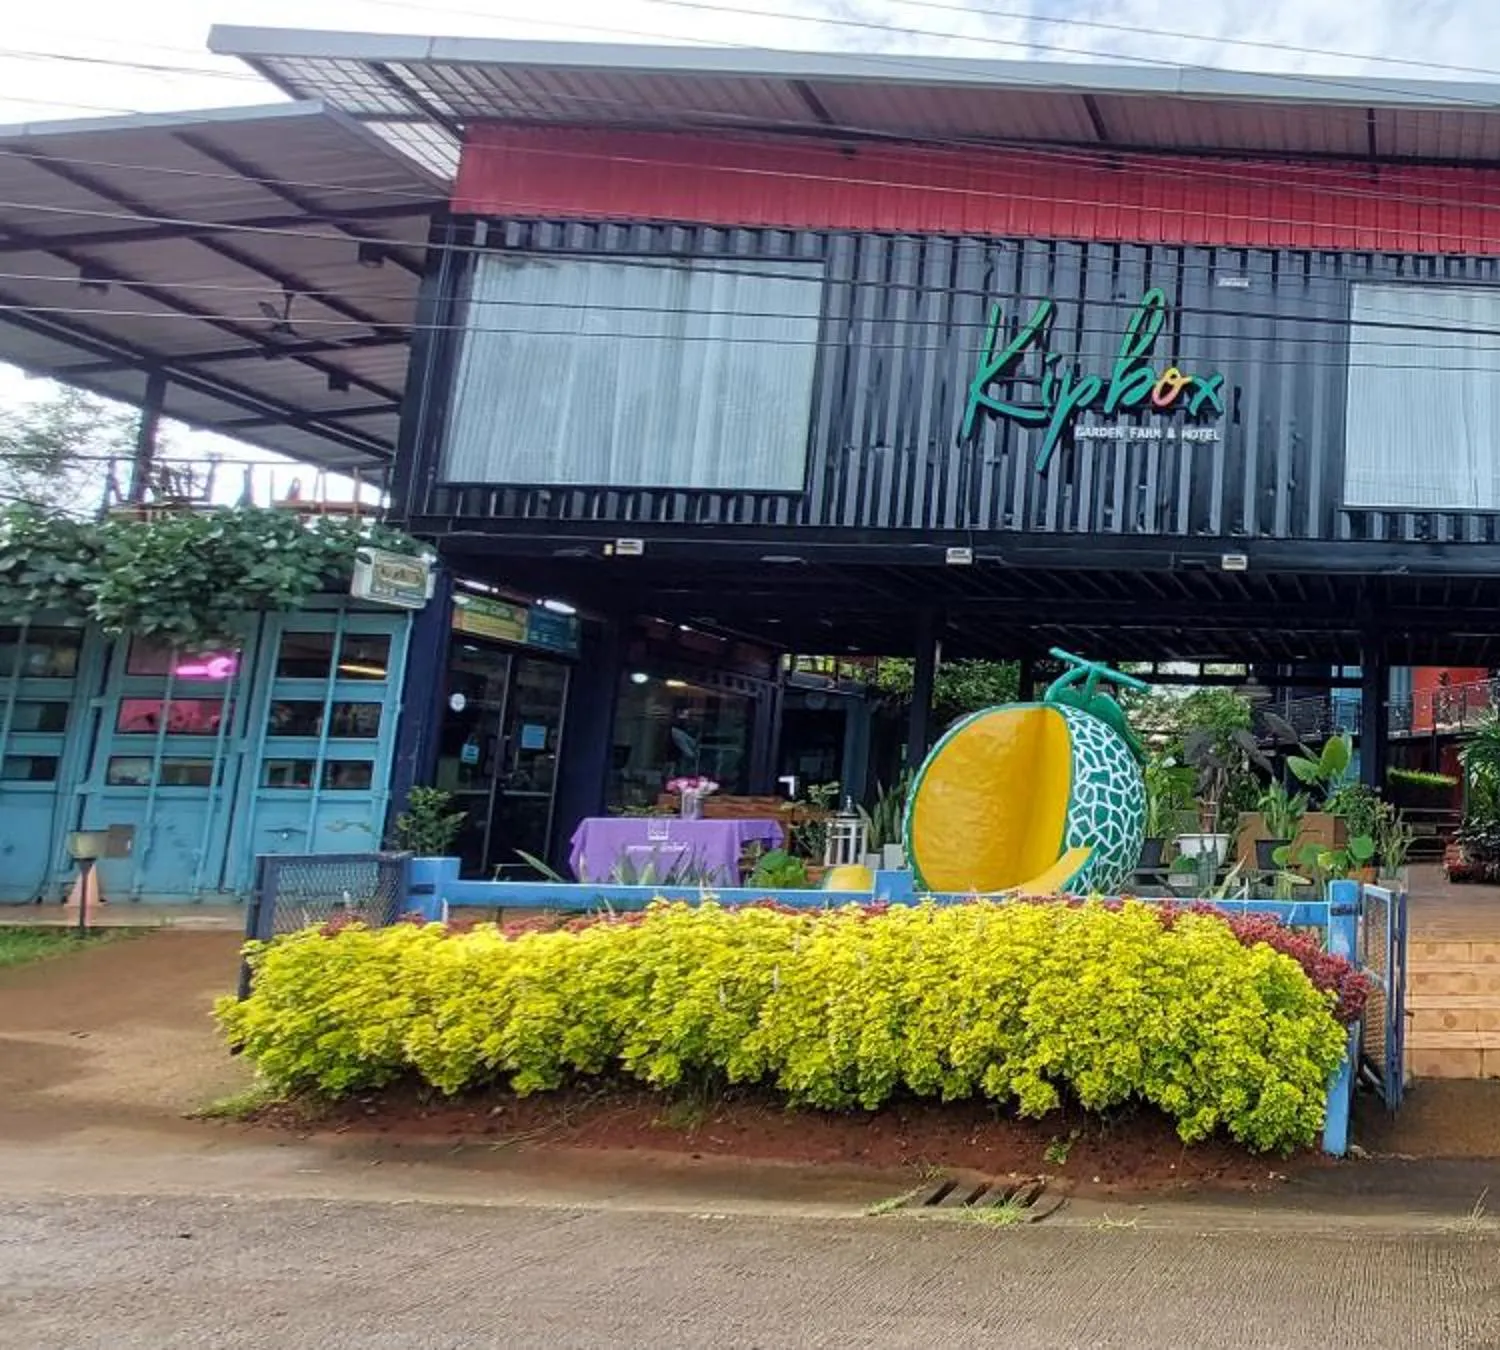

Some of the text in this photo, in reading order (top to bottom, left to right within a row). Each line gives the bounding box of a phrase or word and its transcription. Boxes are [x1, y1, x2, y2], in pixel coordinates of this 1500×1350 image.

[961, 287, 1225, 474] Kipbox
[1074, 425, 1220, 441] GARDEN FARM & HOTEL
